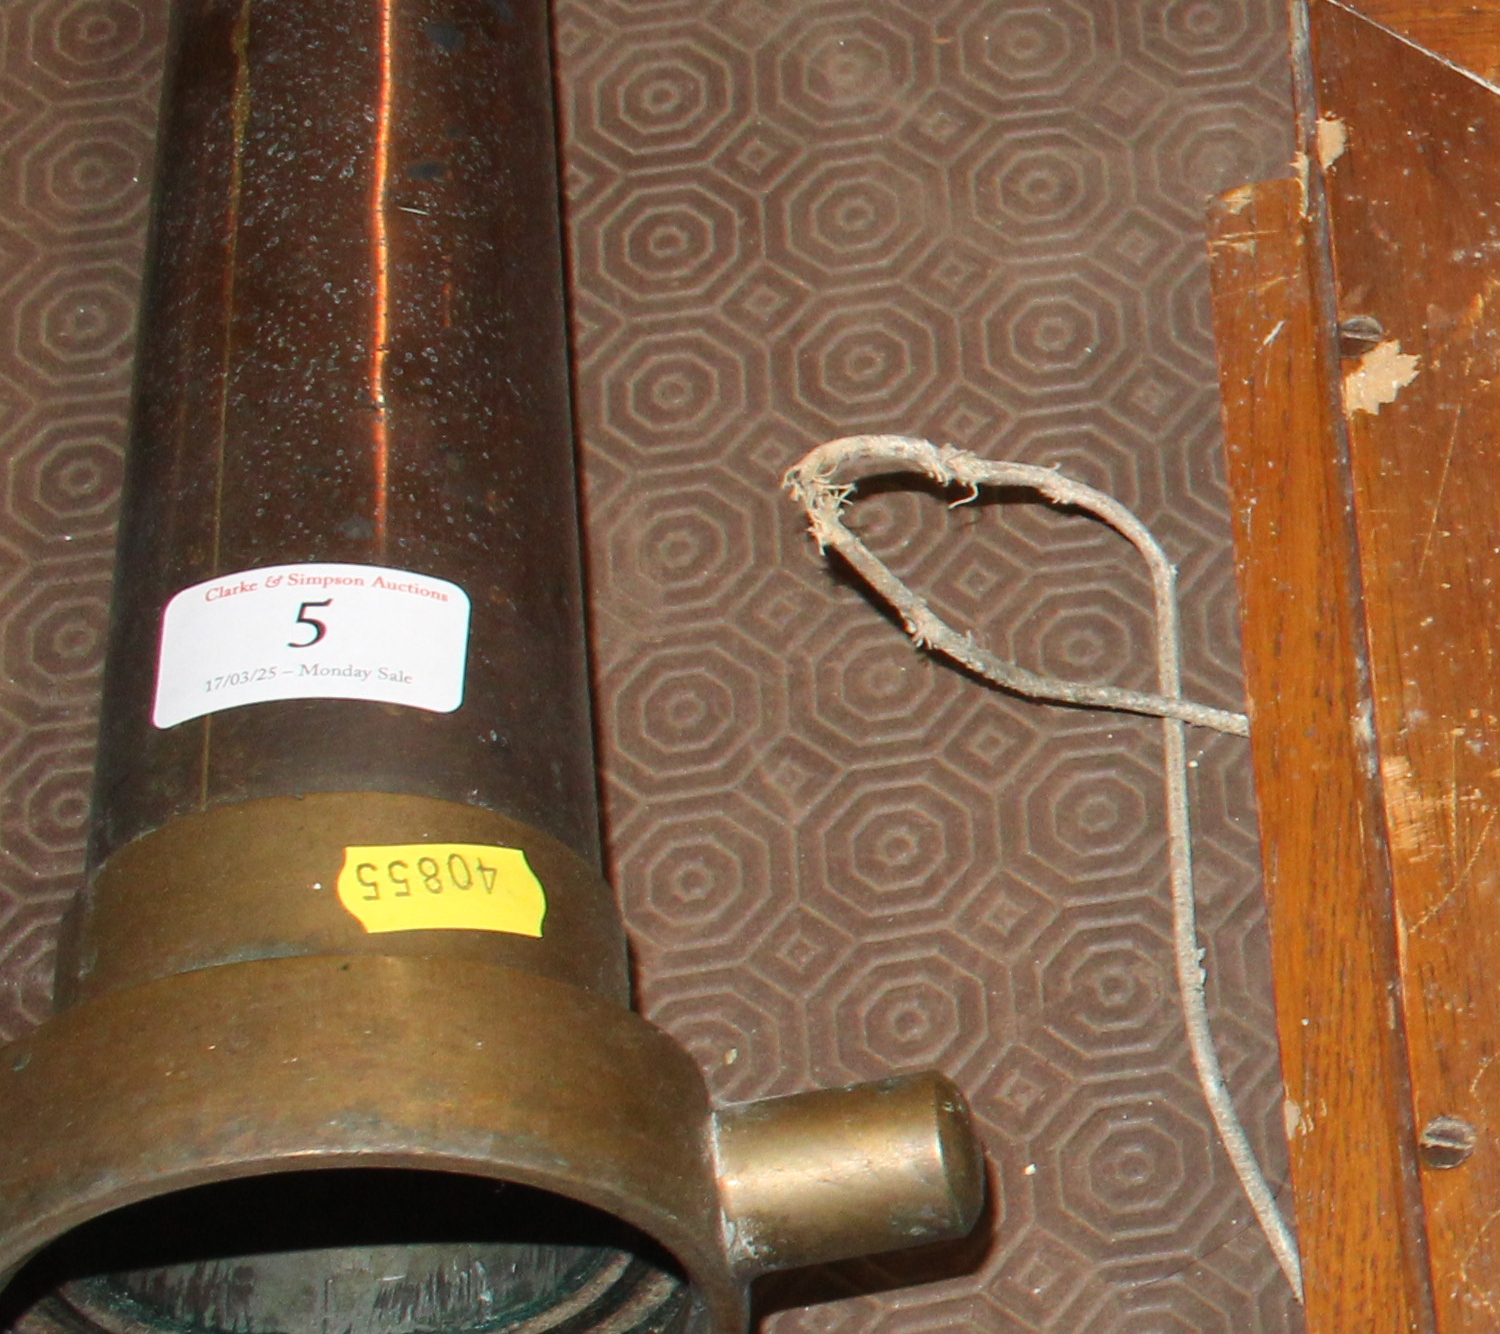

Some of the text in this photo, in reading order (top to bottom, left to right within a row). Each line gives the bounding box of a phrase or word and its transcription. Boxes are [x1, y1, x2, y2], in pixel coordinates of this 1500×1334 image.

[204, 573, 450, 603] Clarke & Simpson Auctions
[286, 597, 334, 648] 5
[204, 665, 278, 693] 17/03/25
[298, 663, 373, 682] Monday
[377, 665, 413, 685] Sale
[355, 853, 498, 902] 40855
